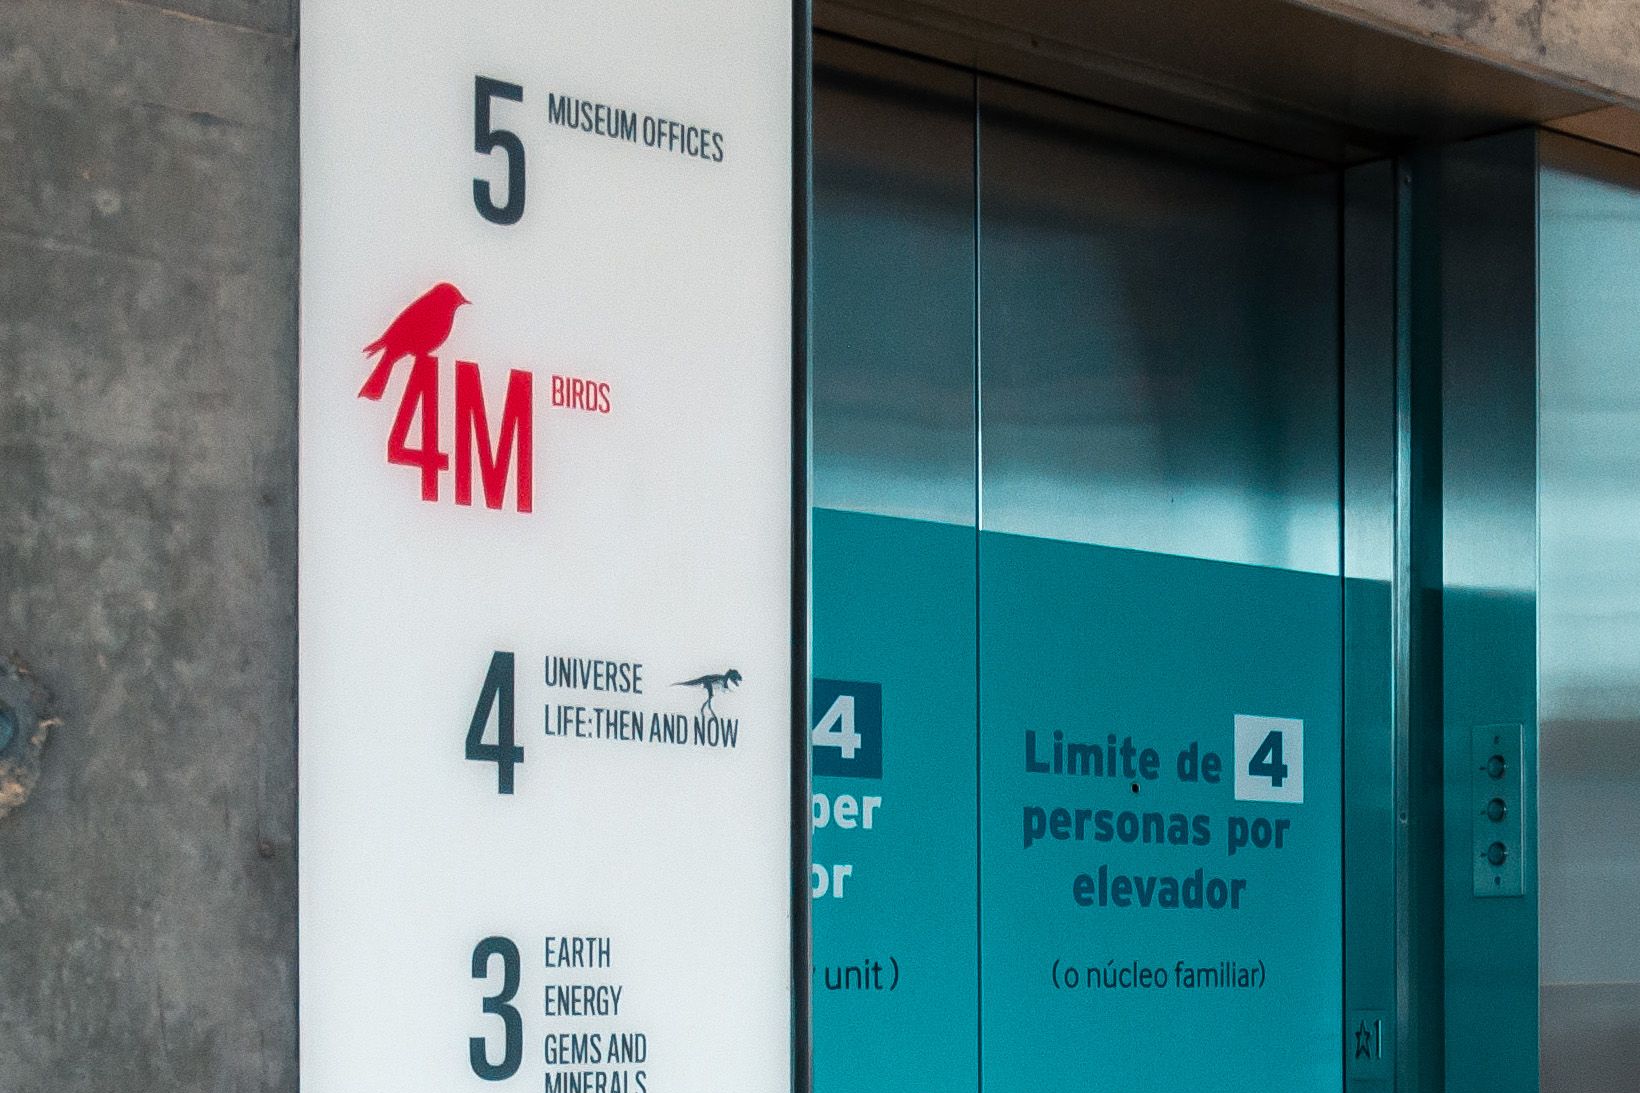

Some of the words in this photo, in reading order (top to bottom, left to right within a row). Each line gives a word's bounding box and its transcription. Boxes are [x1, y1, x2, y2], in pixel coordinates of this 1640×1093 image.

[548, 92, 638, 144] MUSEUM
[642, 117, 725, 163] OFFICES
[474, 75, 526, 226] 5
[551, 374, 611, 414] BIRDS
[387, 354, 533, 513] 4M
[544, 655, 643, 695] UNIVERSE
[465, 650, 525, 795] 4
[649, 712, 688, 746] AND
[693, 716, 739, 748] NOW
[812, 694, 862, 760] 4
[1177, 741, 1222, 784] de
[1248, 730, 1289, 788] 4
[811, 792, 882, 834] per
[1023, 803, 1211, 851] personas
[1227, 813, 1291, 856] por
[1072, 864, 1247, 910] elevador
[544, 937, 611, 968] EARTH
[824, 956, 900, 992] unit)
[1052, 958, 1080, 990] (o
[1087, 957, 1168, 990] núcleo
[1174, 957, 1267, 990] familiar)
[468, 935, 524, 1081] 3
[544, 985, 623, 1017] ENERGY
[544, 1032, 602, 1065] GEMS
[607, 1032, 647, 1064] AND
